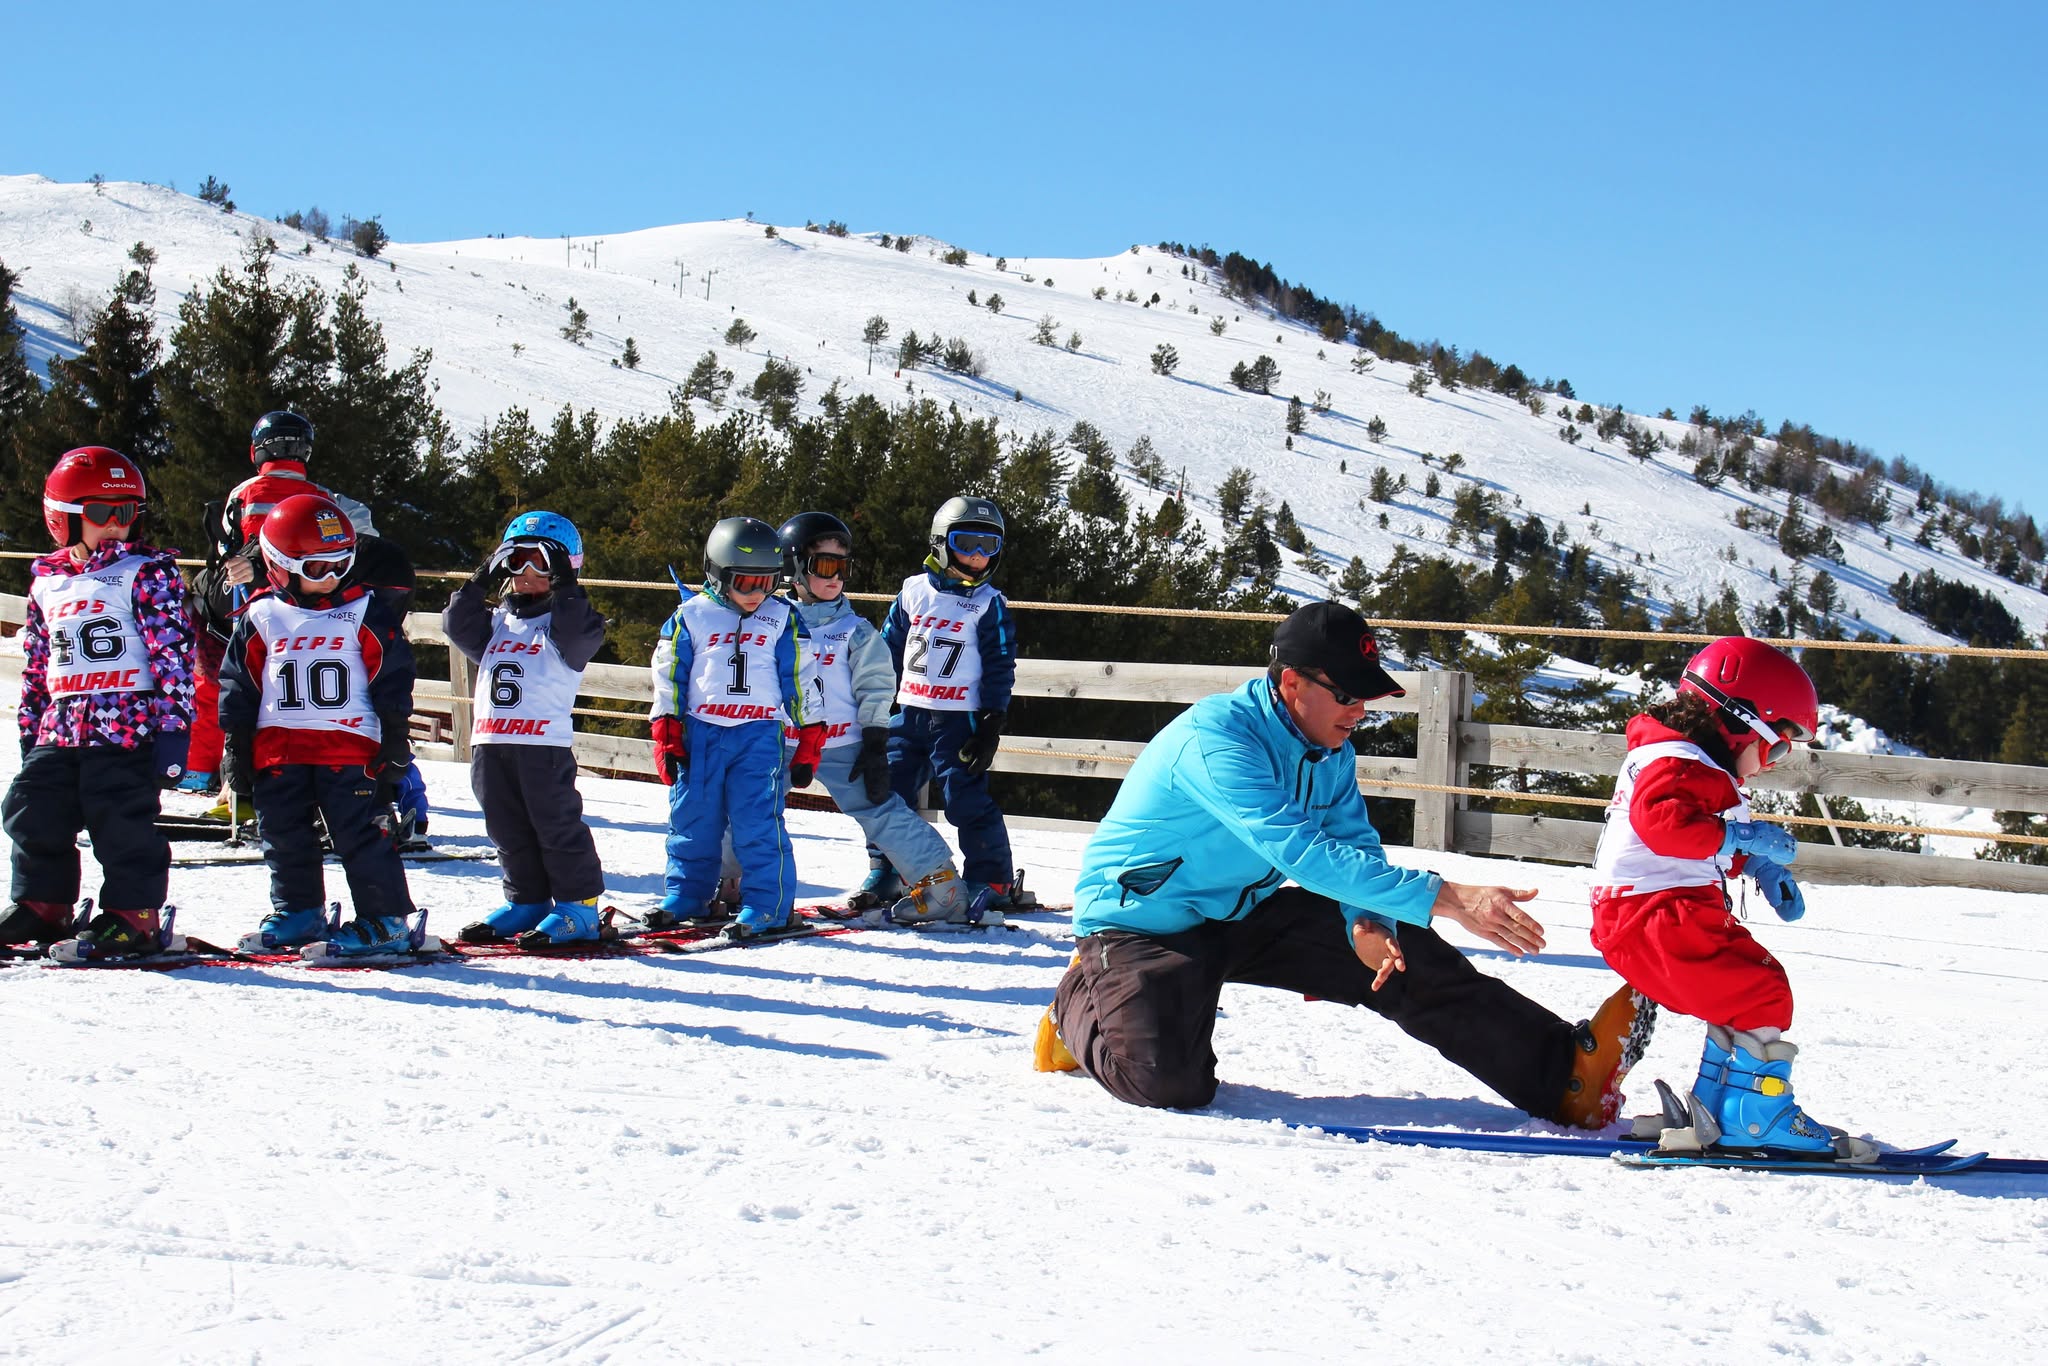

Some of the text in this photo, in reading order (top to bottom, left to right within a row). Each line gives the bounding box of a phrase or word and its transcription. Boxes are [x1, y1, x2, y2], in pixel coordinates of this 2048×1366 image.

[264, 436, 300, 445] CEB
[49, 600, 105, 622] SCPS
[956, 601, 980, 611] NATEC
[328, 611, 356, 620] NATEC
[753, 614, 779, 627] NATEC
[911, 615, 966, 632] SCPS
[51, 616, 126, 666] 46
[275, 636, 345, 653] SCPS
[708, 633, 768, 647] SCPS
[823, 632, 848, 640] NATEC
[907, 633, 966, 678] 27
[727, 652, 751, 696] 1
[277, 659, 350, 710] 10
[489, 660, 525, 709] 6
[902, 681, 968, 700] CAMURAC
[696, 704, 777, 719] CAMURAC
[475, 718, 551, 735] CAMURAC
